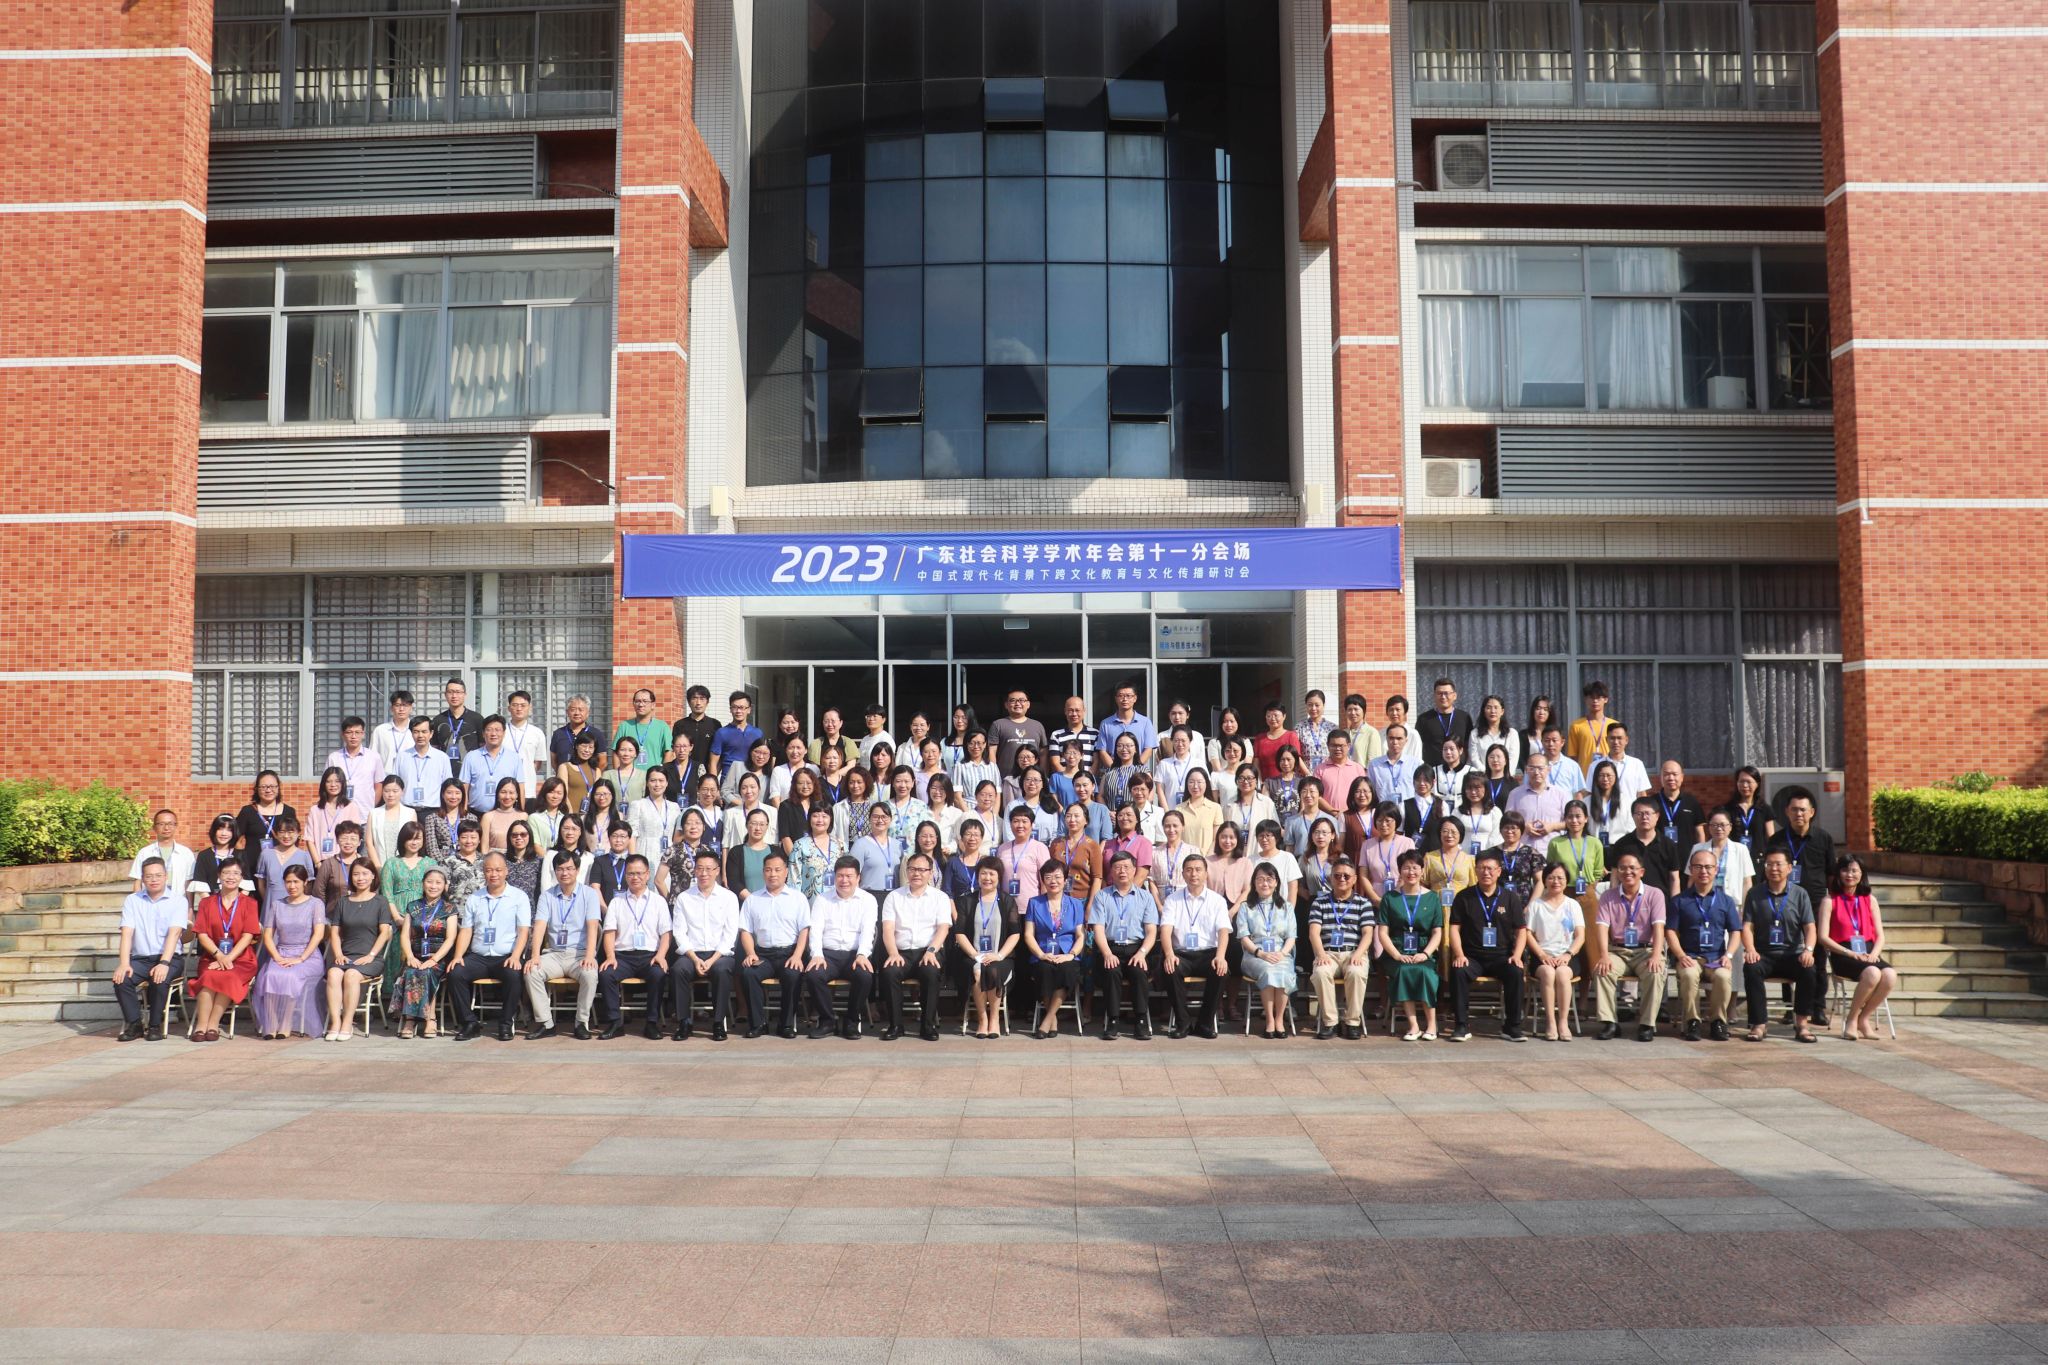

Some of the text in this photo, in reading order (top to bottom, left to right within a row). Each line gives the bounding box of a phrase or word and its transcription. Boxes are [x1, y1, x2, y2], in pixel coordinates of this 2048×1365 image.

[917, 542, 1250, 564] 广东社会科学学术年会第十一分会场
[771, 545, 888, 583] 2023
[917, 566, 1250, 582] 中国式现代化背景下跨文化教育与文化传播研讨会
[1160, 641, 1207, 650] 与信息技术中
